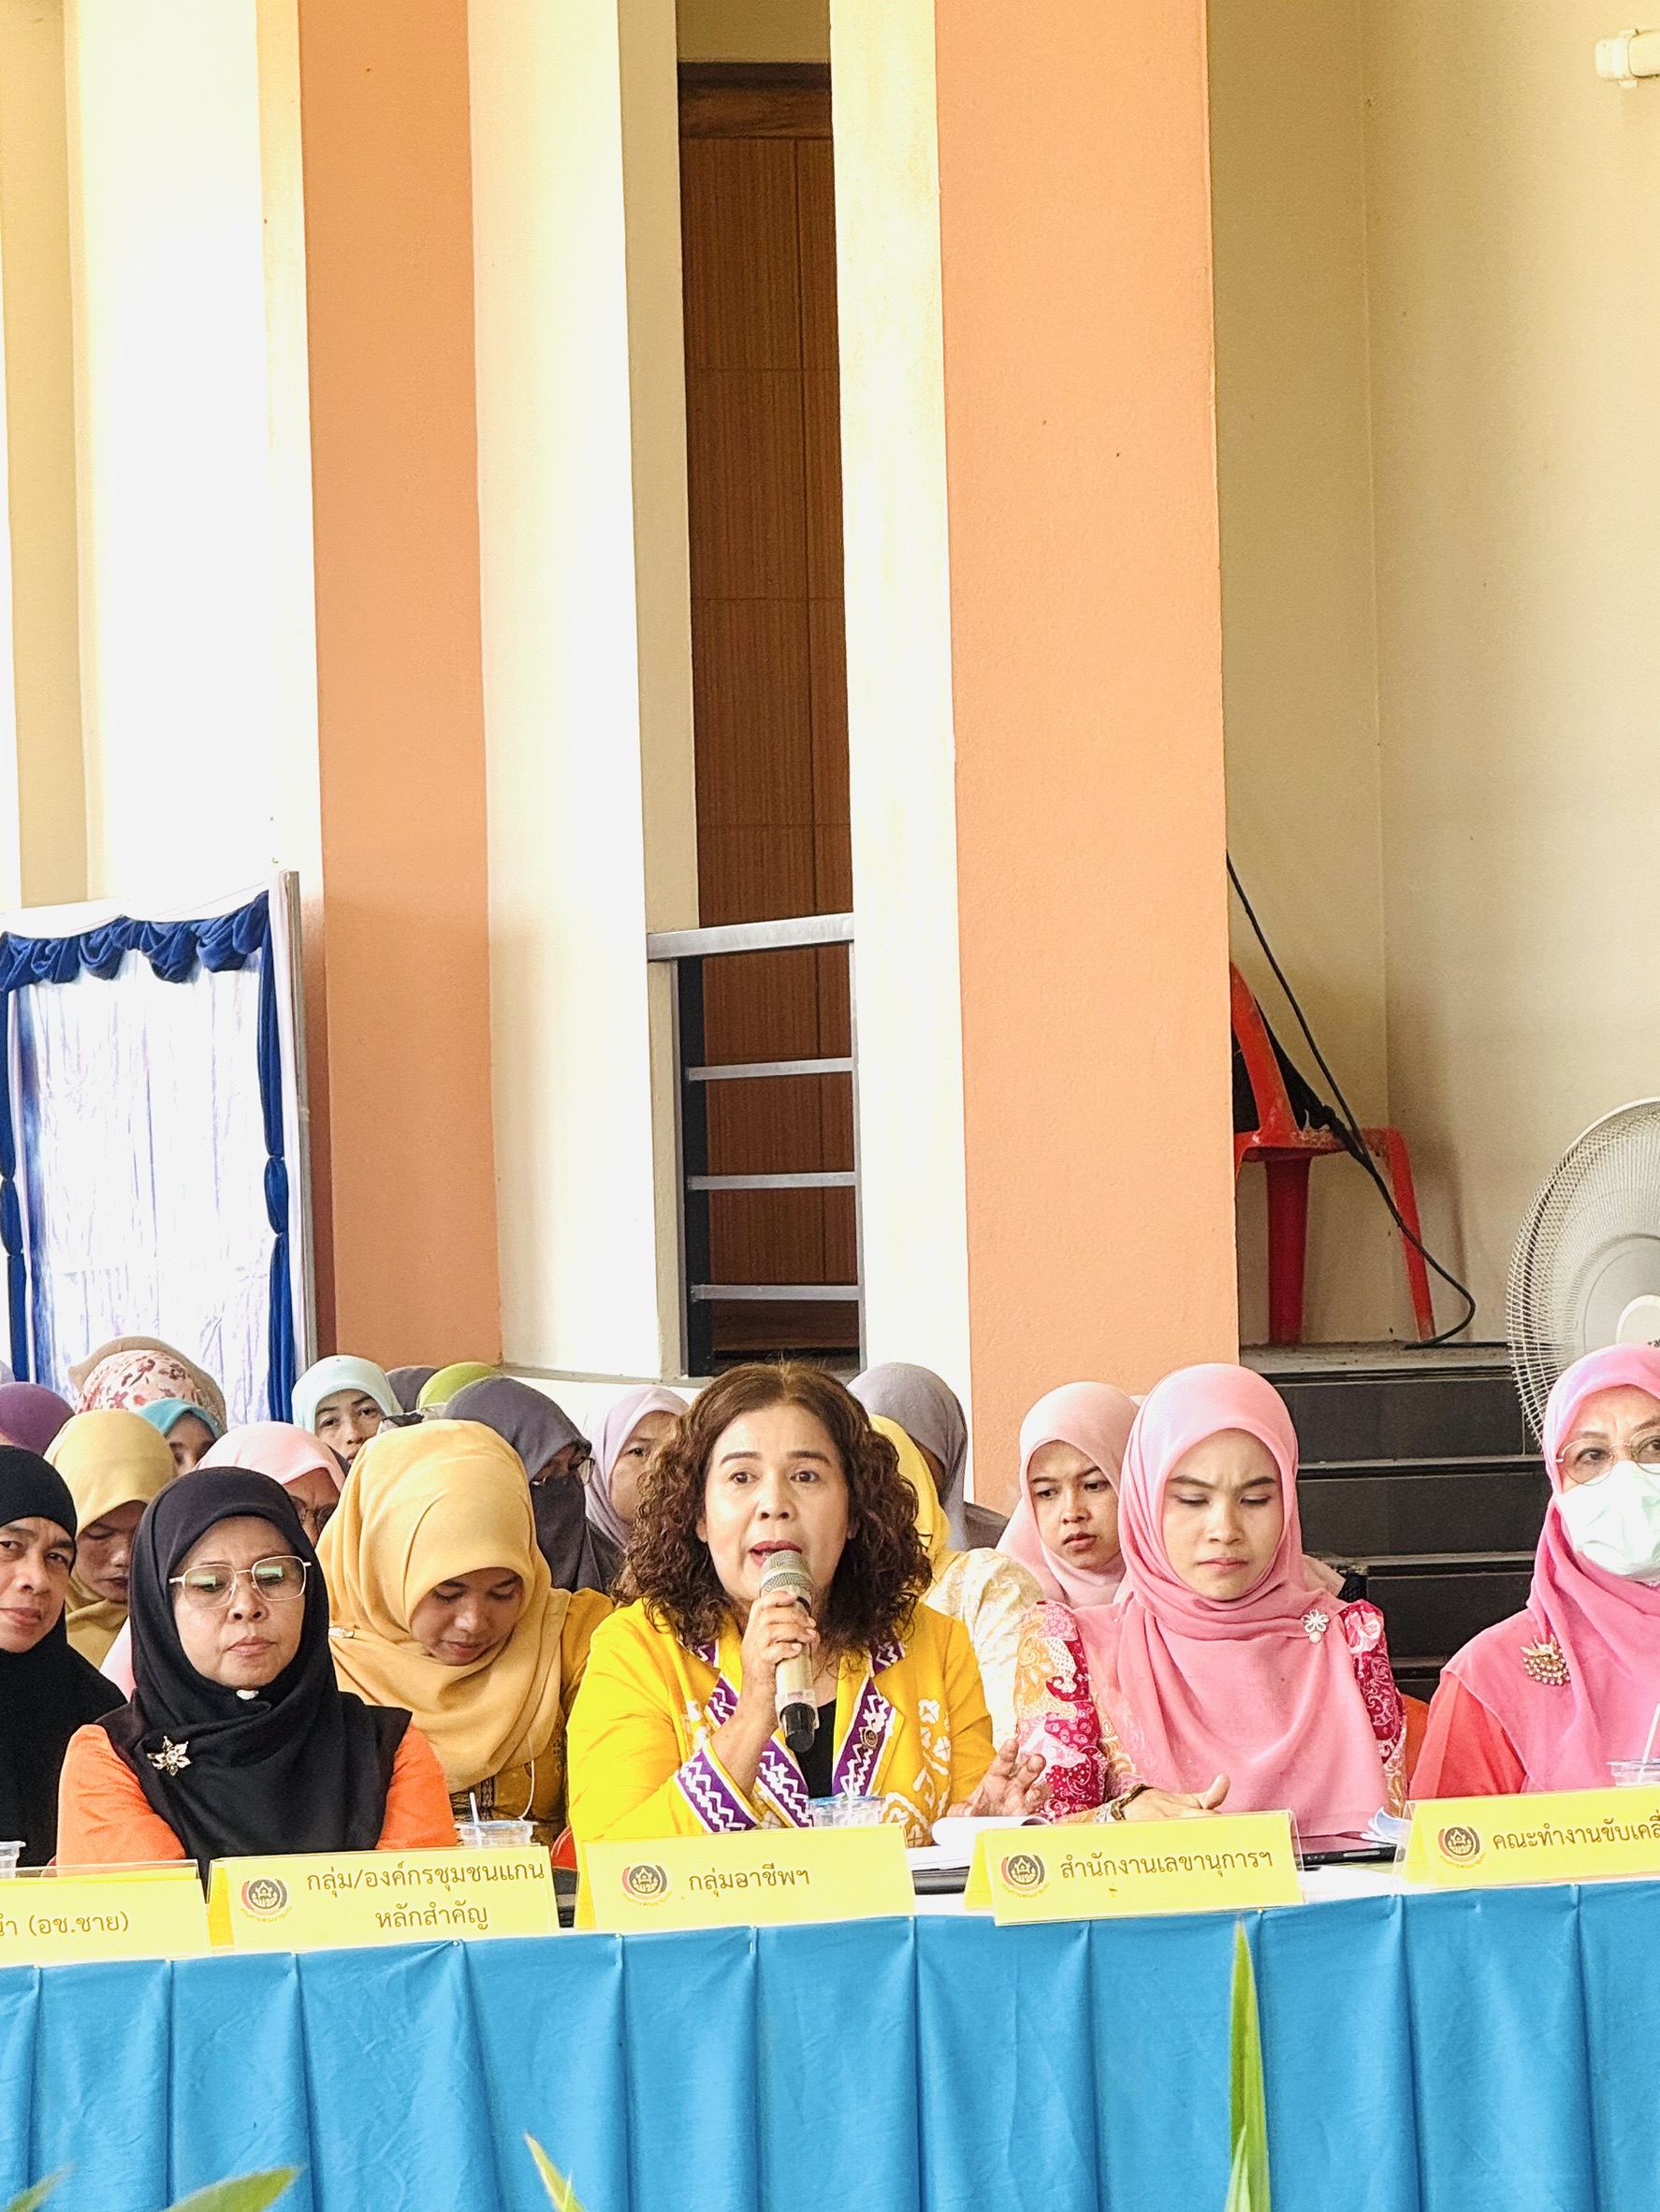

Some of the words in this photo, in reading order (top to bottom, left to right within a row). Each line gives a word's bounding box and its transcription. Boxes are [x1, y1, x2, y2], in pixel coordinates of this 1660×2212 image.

[307, 1860, 546, 1898] กลุ่ม/องค์กรชุมชนแกน
[689, 1863, 810, 1898] กลุ่มอาชีพฯ
[1060, 1851, 1274, 1879] สำนักงานเลขานุการฯ
[28, 1911, 129, 1936] (อช.ชาย)
[375, 1899, 488, 1930] หลักสำคัญ
